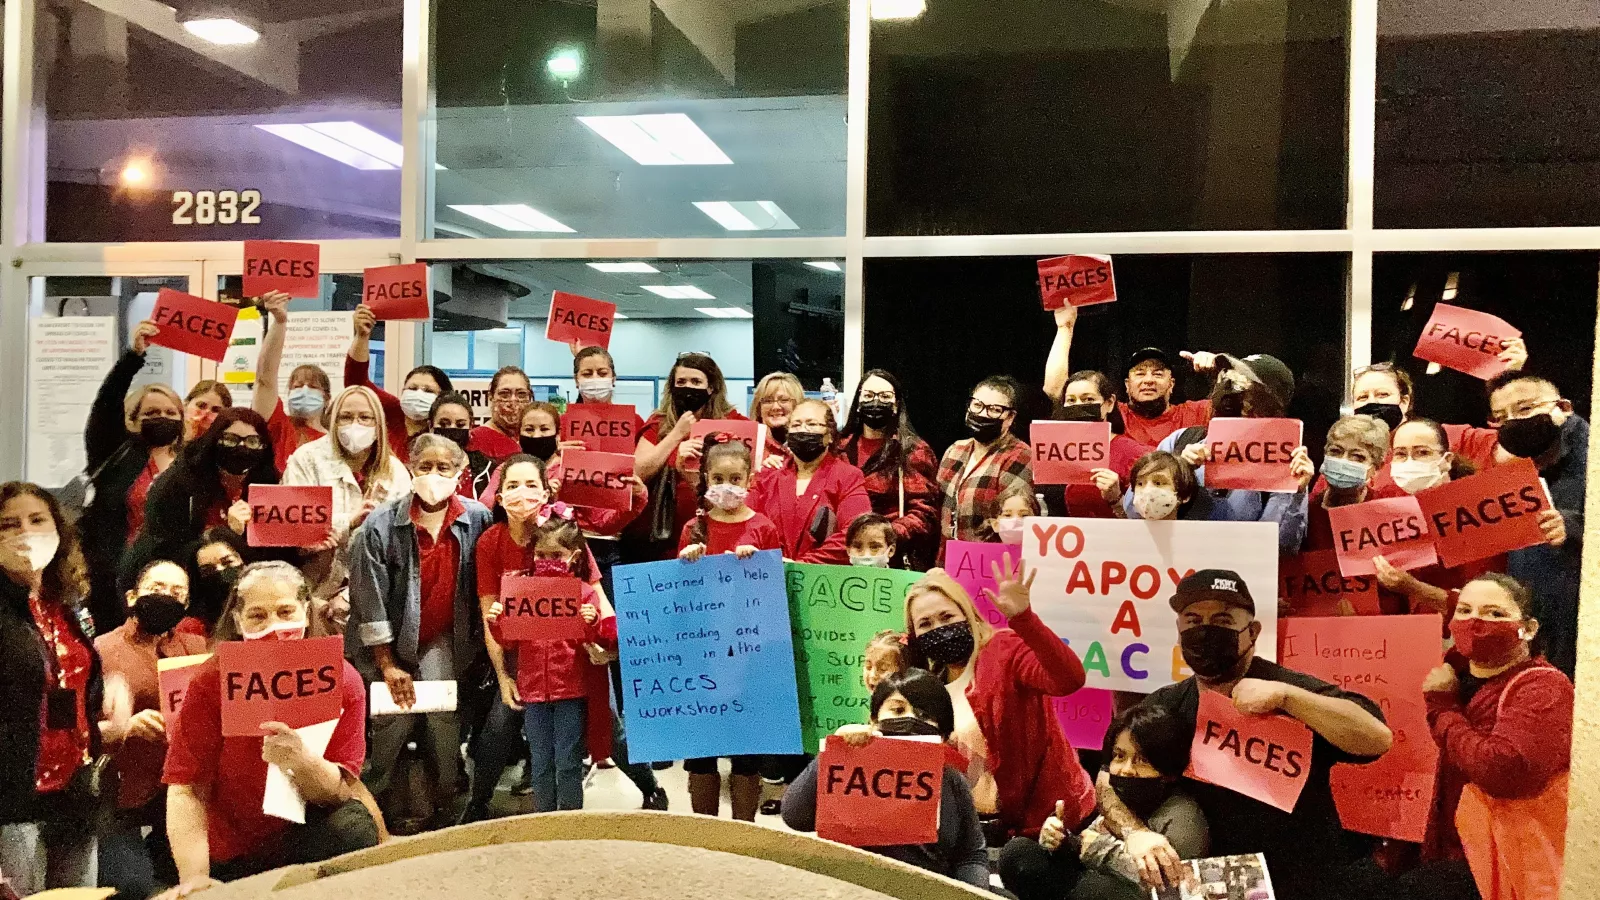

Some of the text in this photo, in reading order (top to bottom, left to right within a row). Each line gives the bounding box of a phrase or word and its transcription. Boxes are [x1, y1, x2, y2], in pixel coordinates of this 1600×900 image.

[172, 190, 262, 225] 2832
[247, 258, 314, 279] FACES
[1044, 266, 1108, 292] FACES
[367, 280, 423, 302] FACES
[155, 306, 229, 341] FACES
[554, 308, 610, 332] FACES
[570, 420, 631, 437] FACES
[1035, 442, 1104, 462] FACES
[1210, 442, 1294, 464] FACES
[564, 468, 628, 490] FACES
[254, 504, 328, 524] FACES
[1432, 486, 1542, 538] FACES
[1032, 524, 1084, 558] YO
[1340, 515, 1422, 552] FACES
[624, 568, 769, 594] I learned to help
[786, 570, 914, 613] FACE
[1285, 571, 1371, 598] FACES
[504, 597, 578, 617] FACES
[626, 597, 760, 622] my children in
[1111, 600, 1142, 637] A
[676, 628, 720, 642] reading
[736, 626, 760, 636] and
[792, 628, 856, 642] OVIDES
[630, 642, 761, 666] writing in the
[1284, 633, 1386, 660] I learned
[828, 651, 866, 668] SUP
[226, 666, 336, 700] FACES
[633, 674, 717, 698] FACES
[1332, 669, 1388, 686] speak
[832, 695, 870, 710] OUR
[1202, 720, 1302, 778] FACES
[826, 765, 934, 802] FACES
